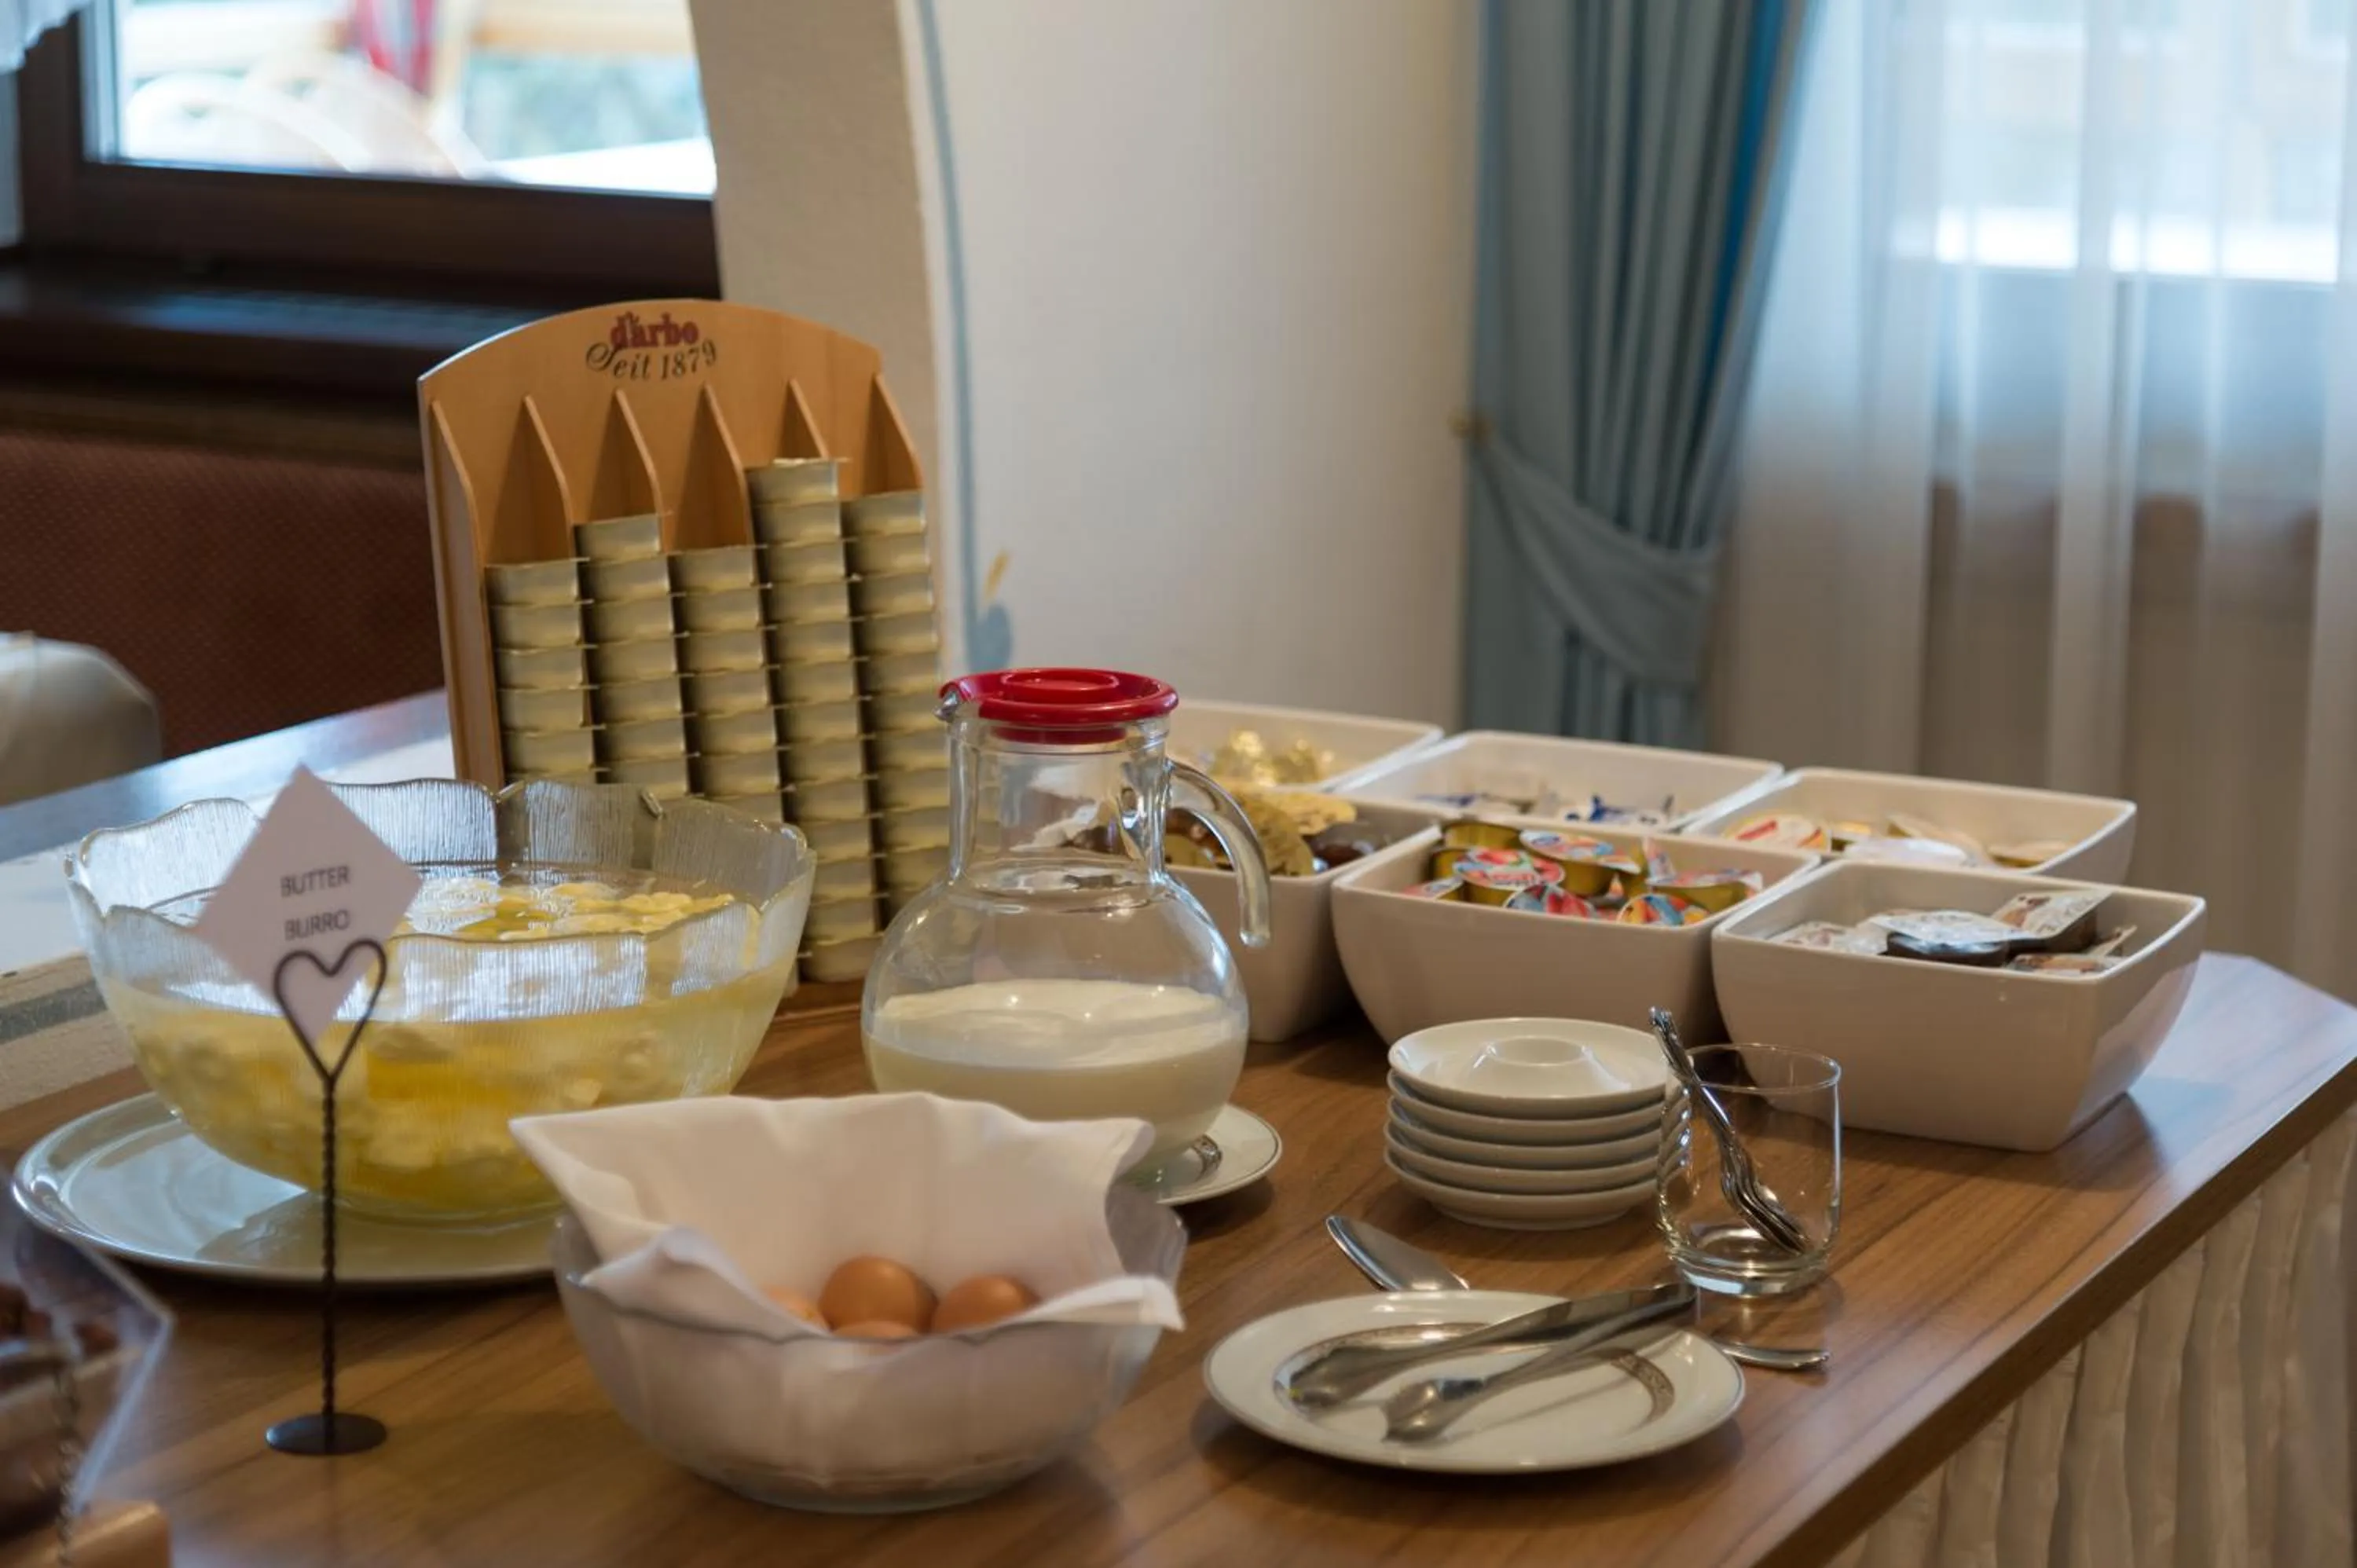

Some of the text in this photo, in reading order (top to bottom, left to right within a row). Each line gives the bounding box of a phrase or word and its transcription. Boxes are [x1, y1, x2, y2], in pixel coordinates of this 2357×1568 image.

[585, 339, 717, 380] Seit 1879
[280, 865, 350, 898] BUTTER
[284, 909, 350, 941] BURRO
